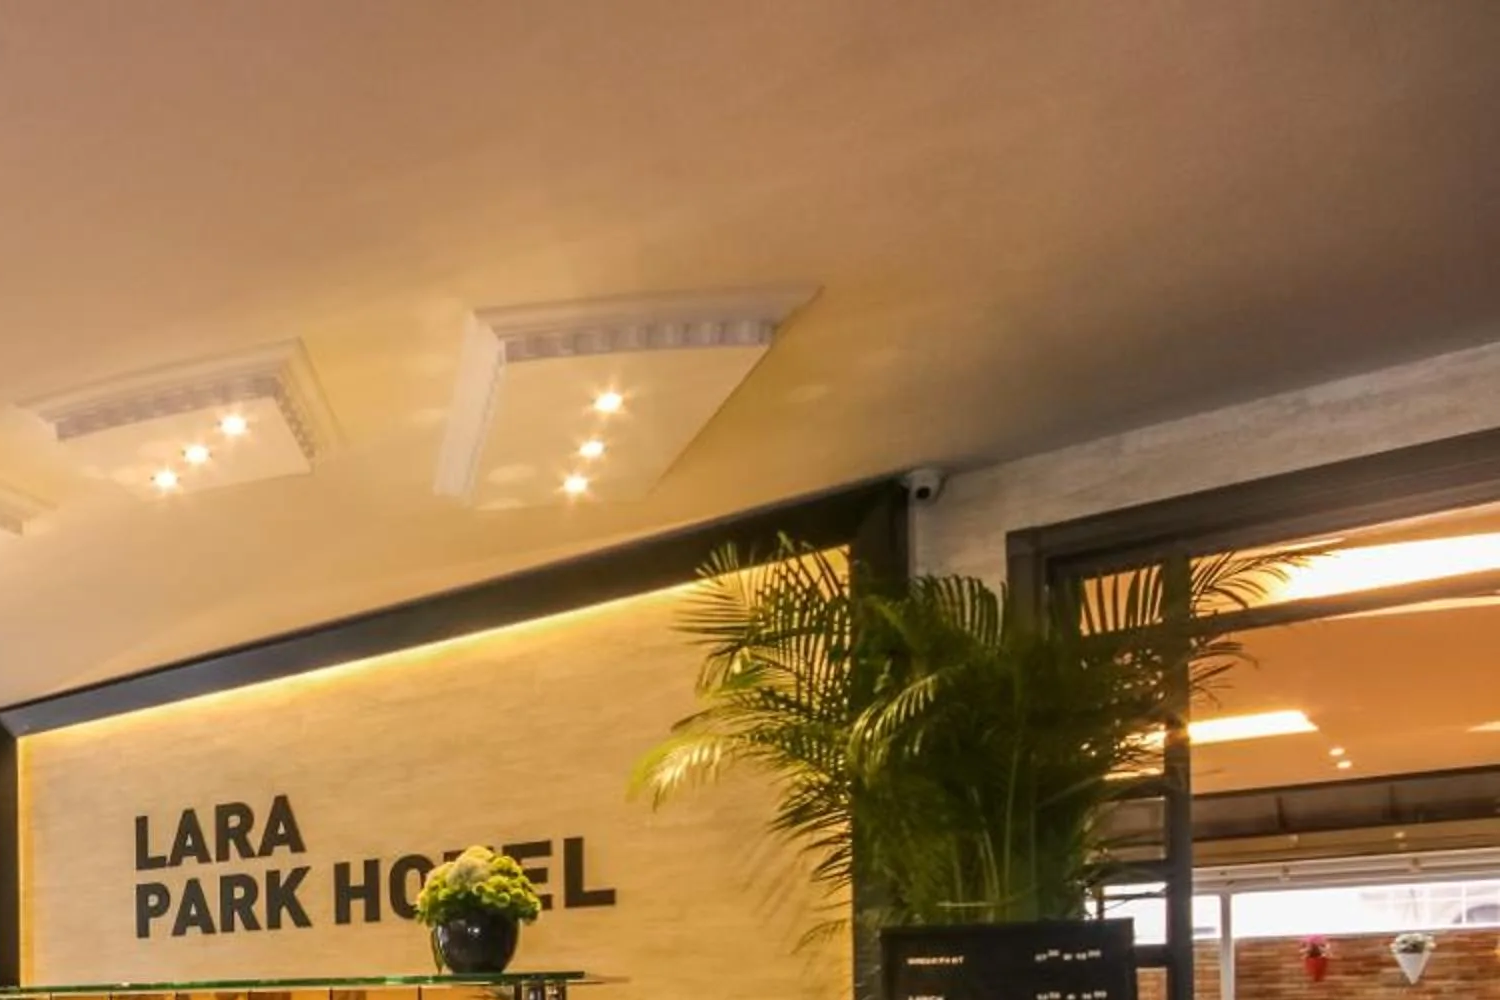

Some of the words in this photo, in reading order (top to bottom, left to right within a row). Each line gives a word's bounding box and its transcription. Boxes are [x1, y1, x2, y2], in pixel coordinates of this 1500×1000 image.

[135, 794, 307, 870] LARA
[136, 865, 313, 938] PARK
[334, 837, 616, 925] HOEL
